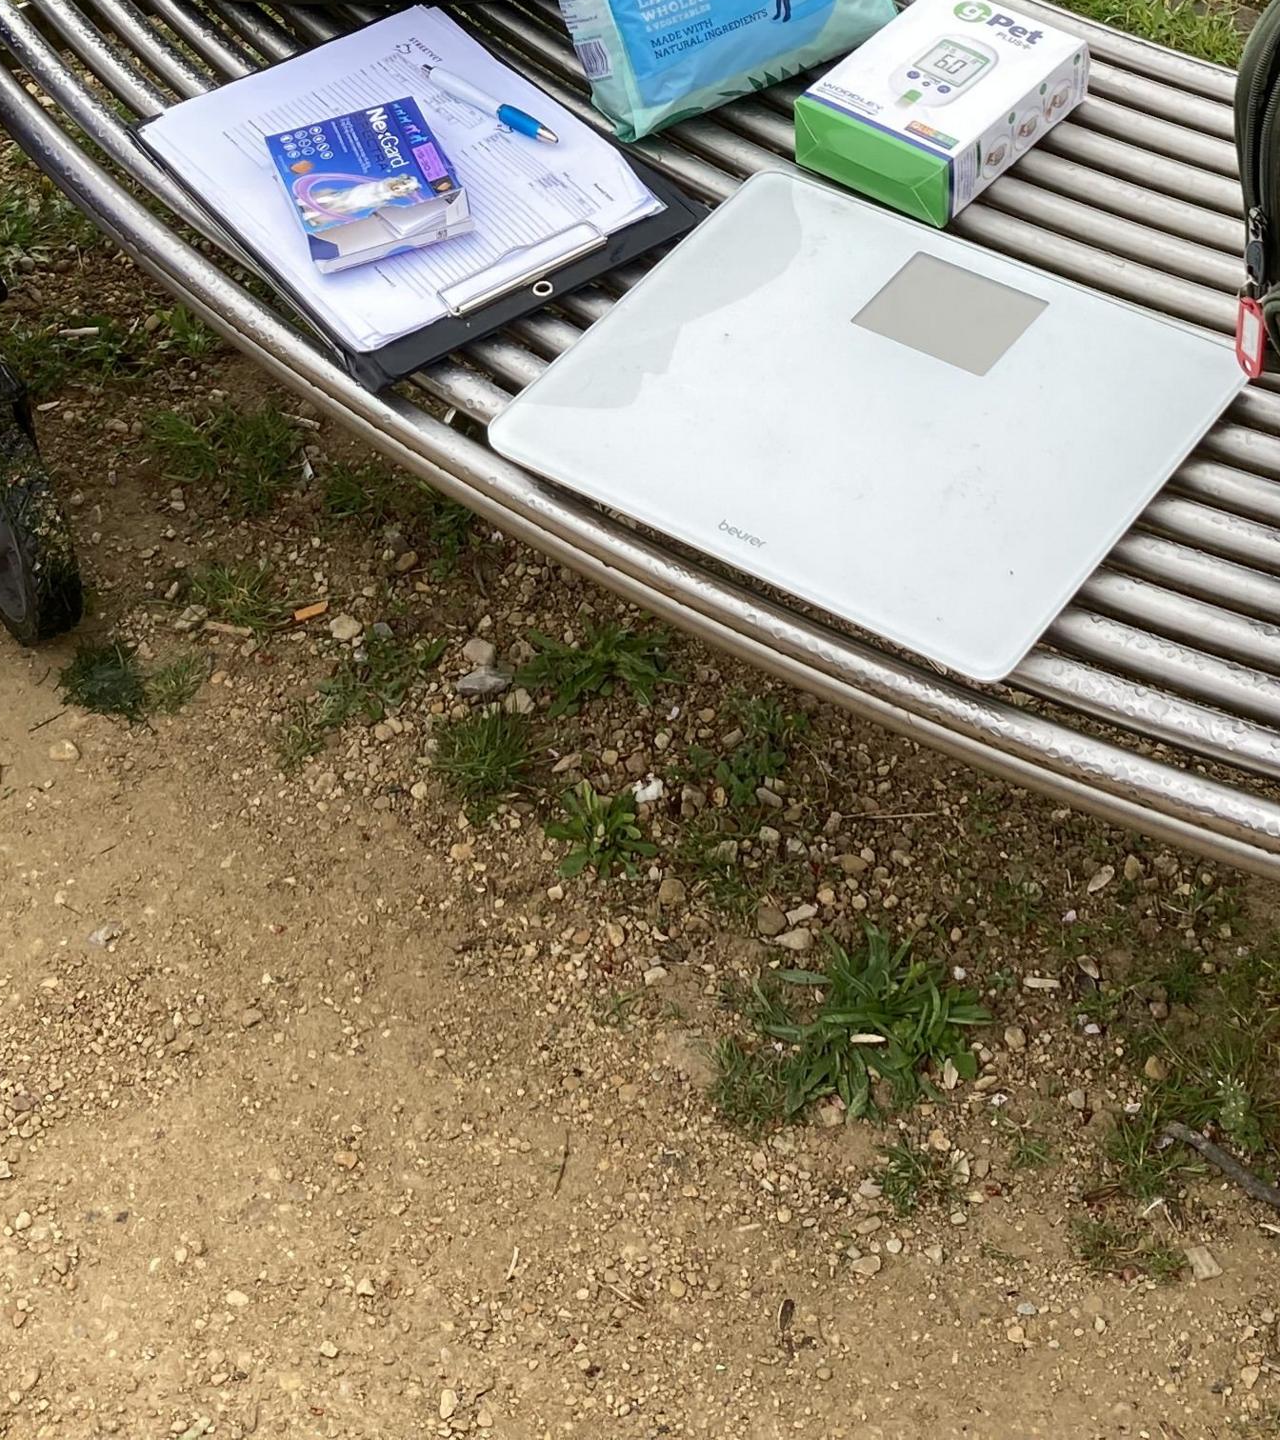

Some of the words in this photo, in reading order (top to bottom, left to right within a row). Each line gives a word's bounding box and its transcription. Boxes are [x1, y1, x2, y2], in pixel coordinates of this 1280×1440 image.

[653, 3, 712, 30] VEGETABLES
[650, 30, 683, 49] MADE
[682, 18, 713, 36] WITH
[654, 35, 703, 60] NATURAL
[704, 8, 769, 41] INGREDIENTS
[822, 81, 884, 111] WOODLEY
[365, 106, 410, 169] NexGard
[718, 519, 767, 548] beurer
